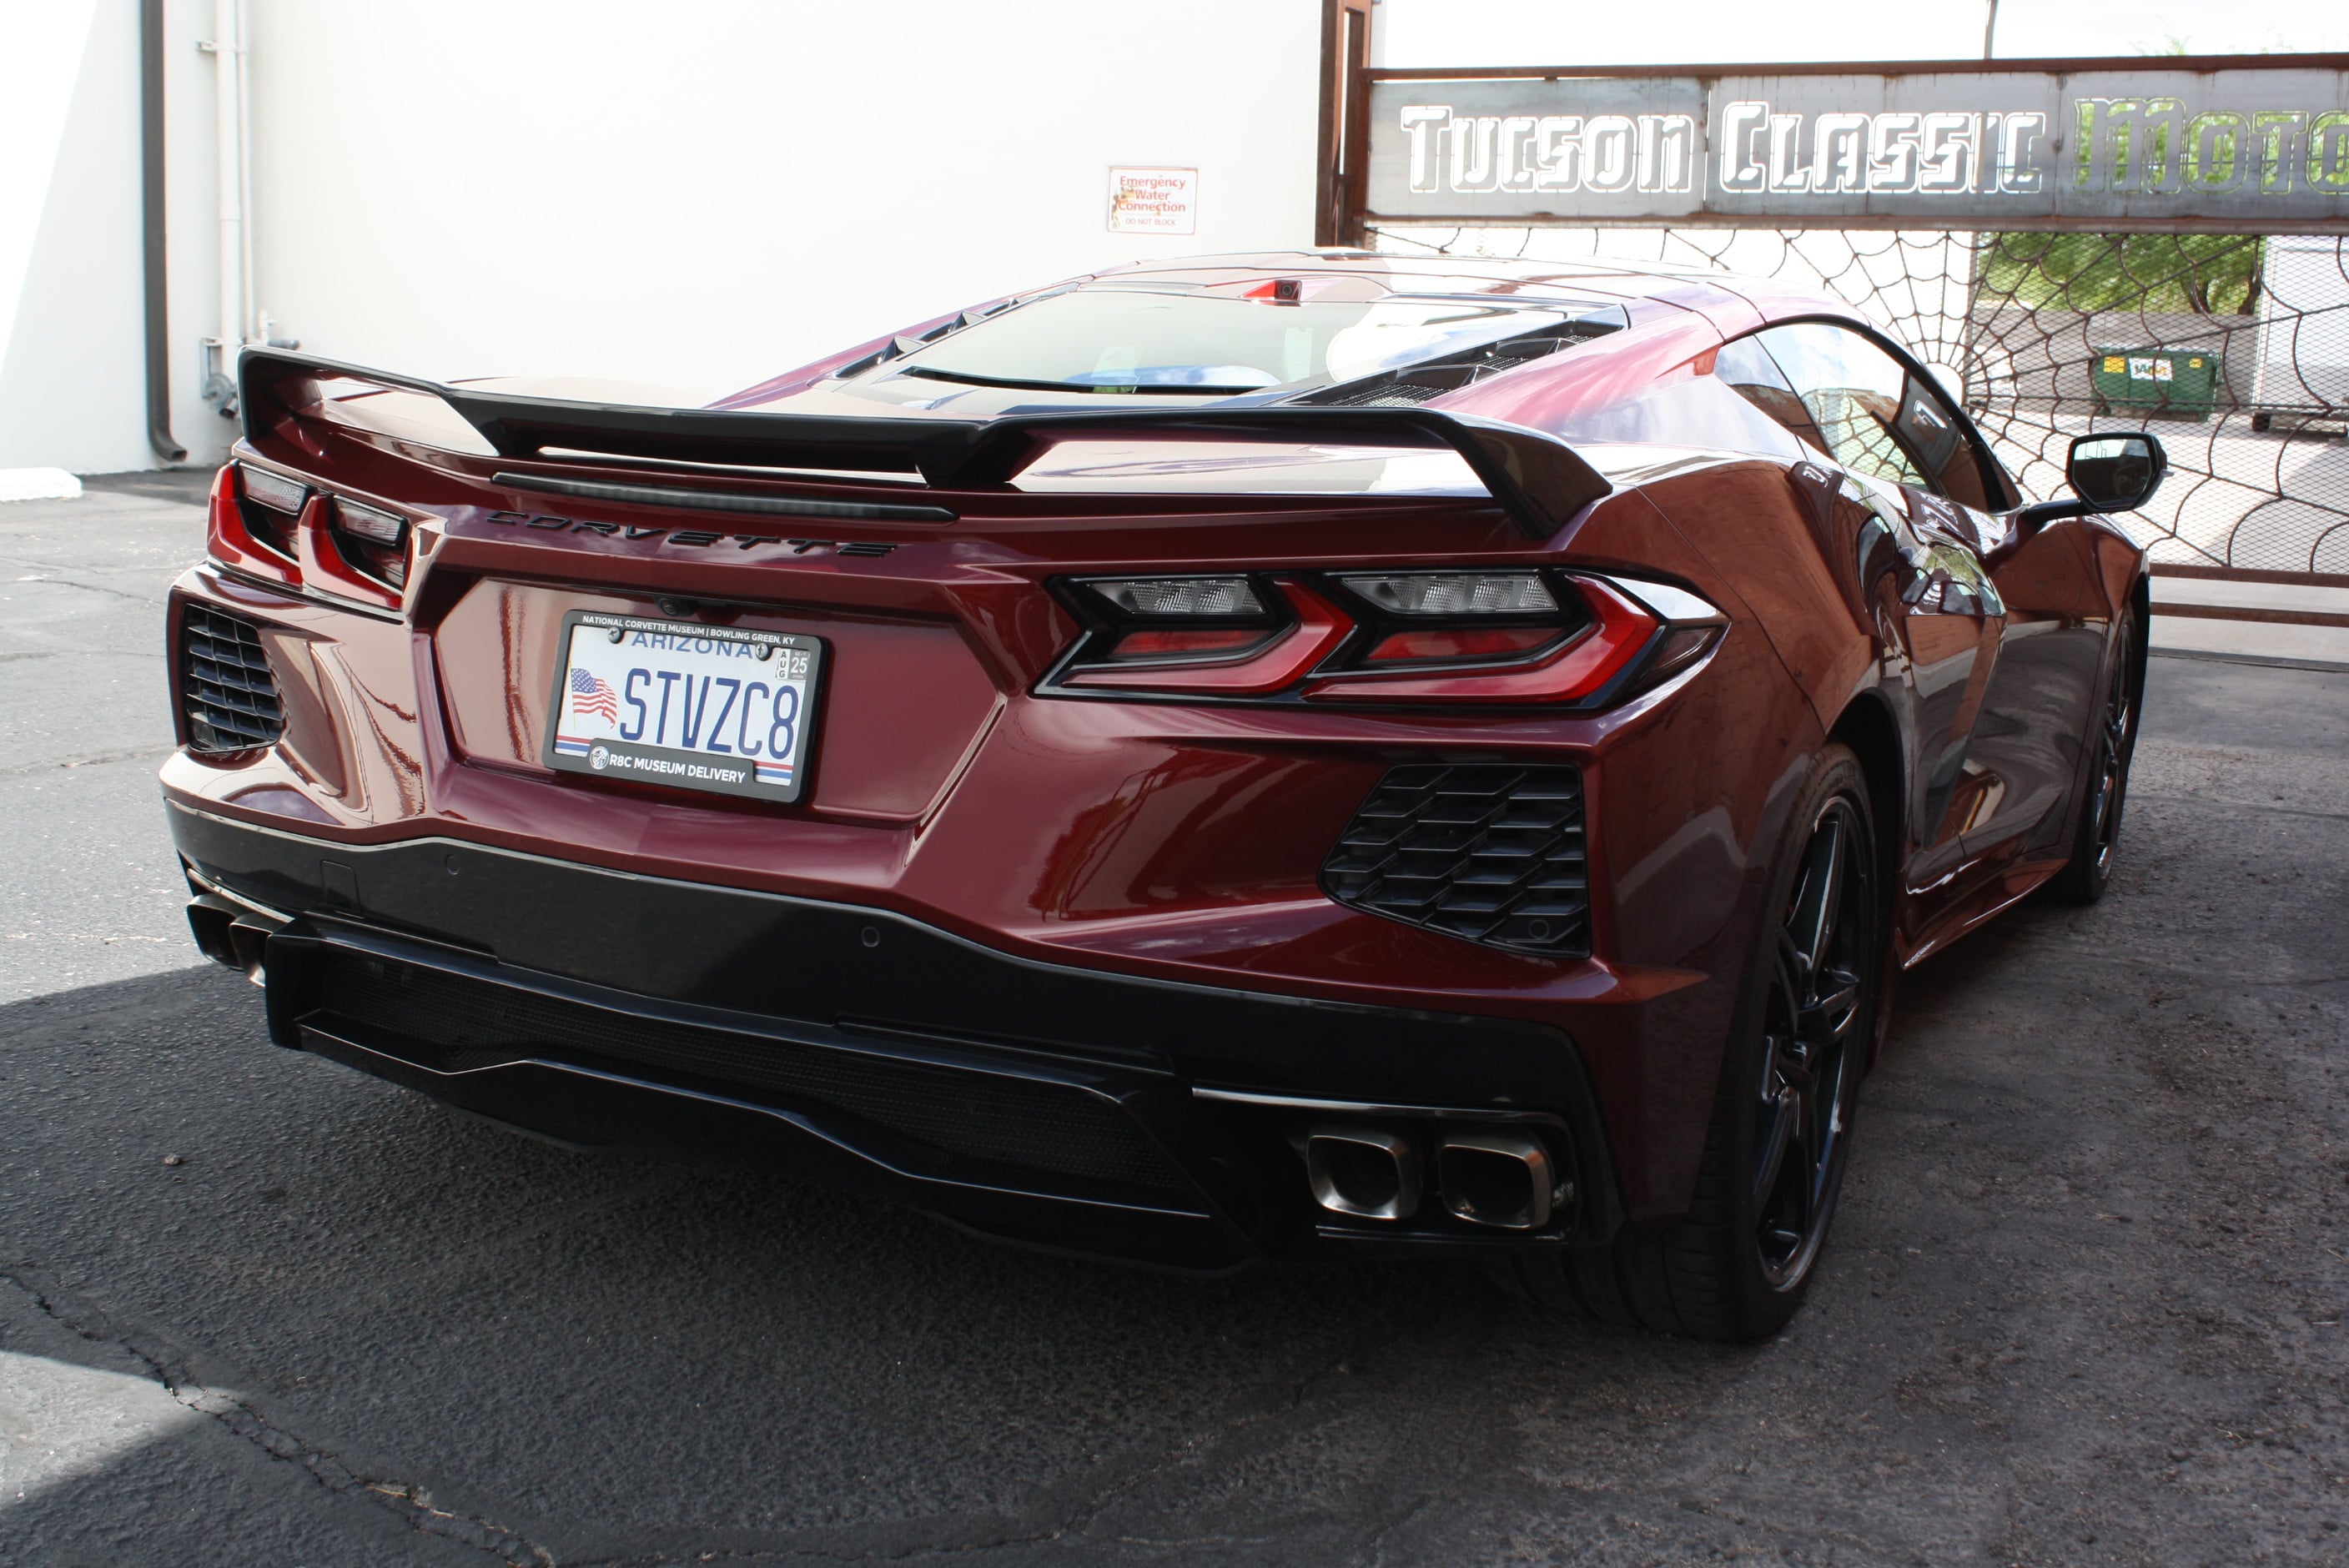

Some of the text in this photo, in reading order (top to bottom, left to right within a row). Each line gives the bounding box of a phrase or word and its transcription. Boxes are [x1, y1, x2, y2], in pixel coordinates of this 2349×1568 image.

[1401, 105, 1696, 193] TUCSON
[1718, 100, 2047, 194] CLASSIC
[1119, 175, 1186, 189] Emergency
[1134, 189, 1169, 200] Water
[1118, 200, 1186, 213] Connection
[1138, 218, 1152, 226] NOT
[1154, 219, 1176, 227] BLOCK
[485, 510, 899, 559] CORVETTE
[582, 616, 623, 627] NATIONAL
[625, 620, 667, 632] CORVETTE
[668, 624, 704, 635] MUSEUM
[710, 629, 750, 641] BOWLING
[752, 633, 782, 645] GREEN,
[782, 636, 795, 646] KY
[631, 631, 753, 659] ARIZONA
[778, 651, 787, 678] AUG
[791, 656, 807, 674] 25
[620, 667, 799, 760] STVZC8
[609, 753, 747, 784] R8C MUSEUM DELIVERY
